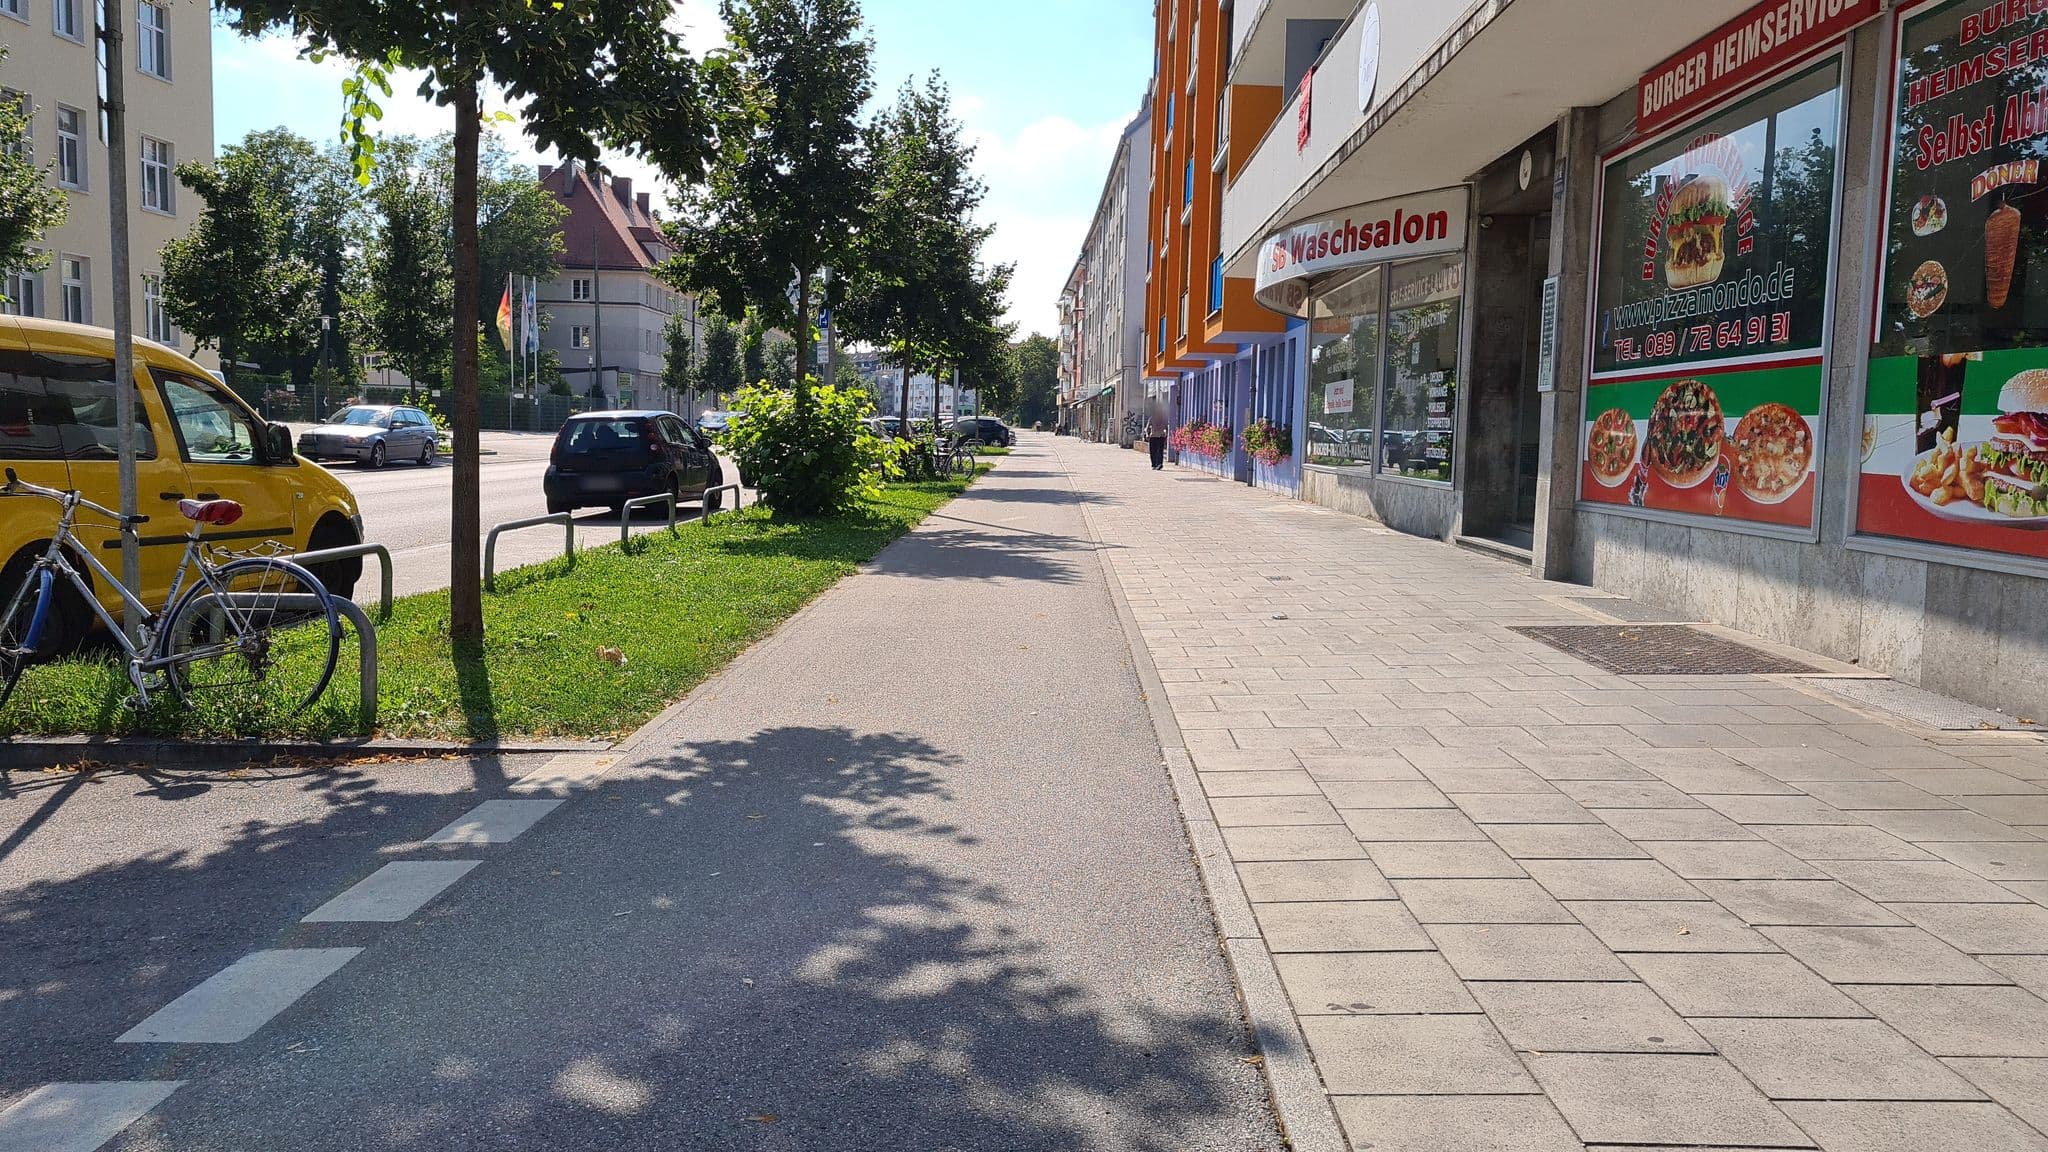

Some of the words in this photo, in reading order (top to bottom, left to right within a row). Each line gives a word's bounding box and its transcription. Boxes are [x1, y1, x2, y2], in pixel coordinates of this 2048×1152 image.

[1643, 51, 1707, 118] BURGER
[1712, 0, 1859, 80] HEIMSERVI
[1916, 105, 1995, 171] Selbst
[1971, 159, 2038, 201] DÖNER
[1272, 239, 1287, 273] SB
[1291, 208, 1448, 266] Waschsalon
[1614, 261, 1795, 331] www.pizzamondo.de
[1645, 330, 1676, 358] 089
[1690, 324, 1713, 352] 72
[1717, 319, 1741, 348] 64
[1747, 315, 1767, 344] 91
[1771, 311, 1791, 342] 31
